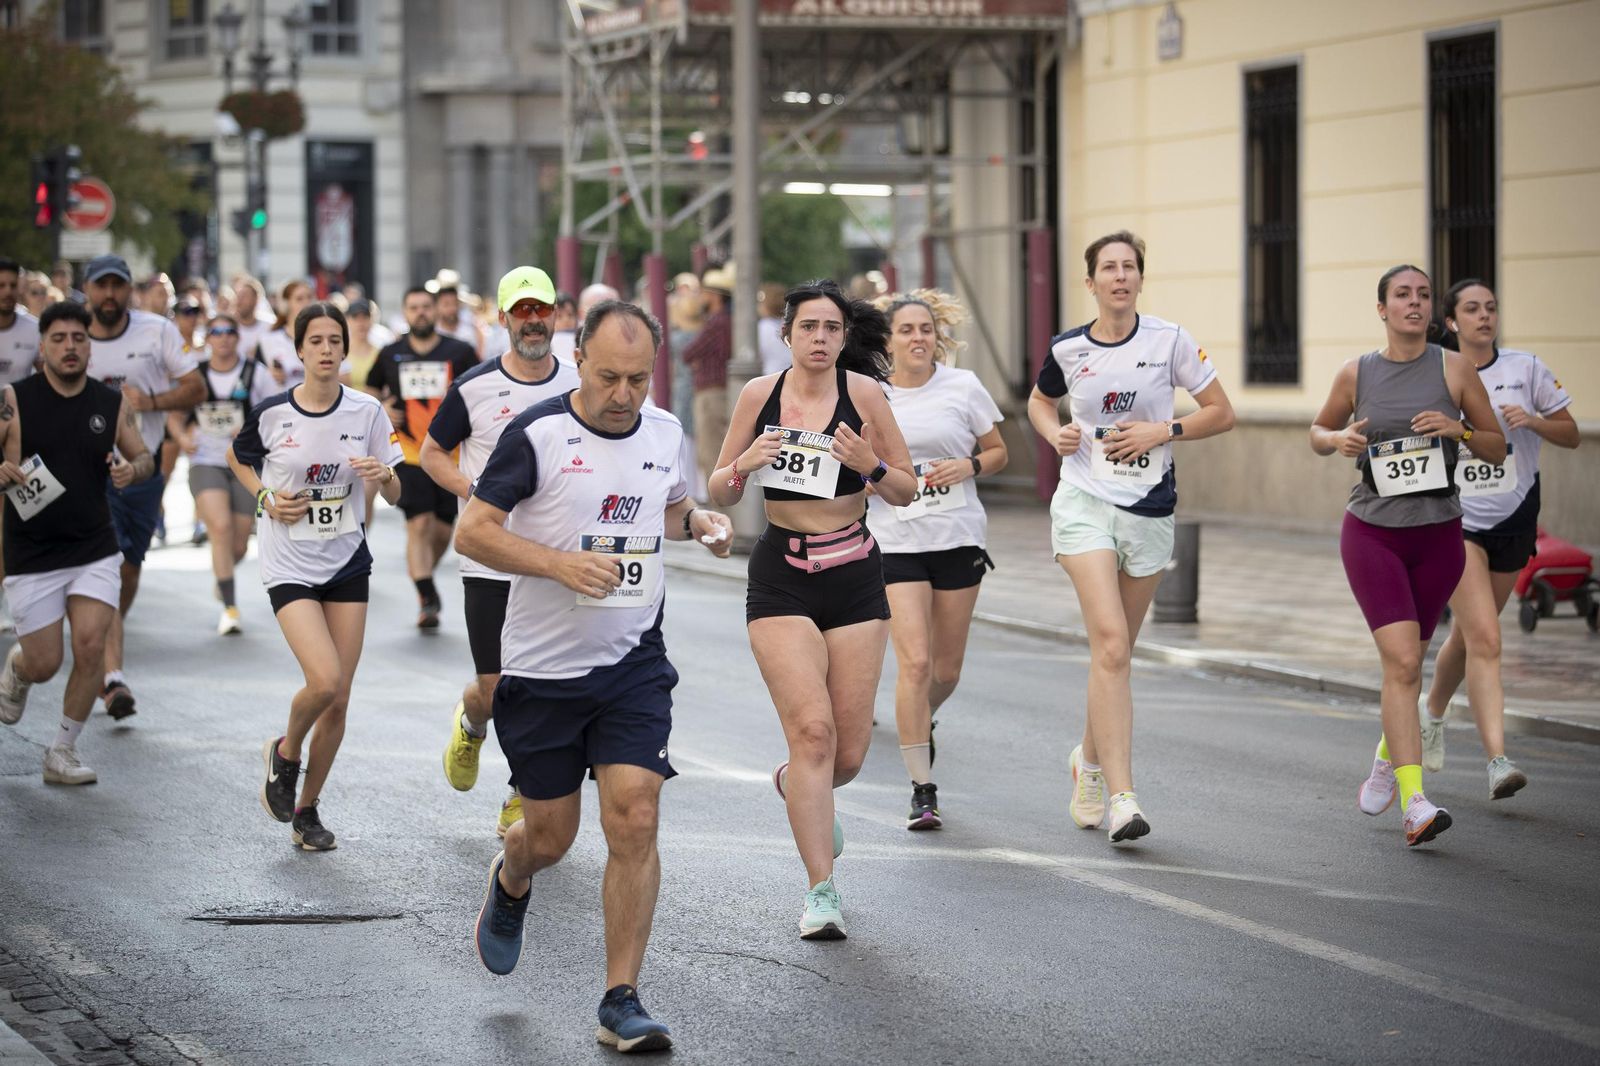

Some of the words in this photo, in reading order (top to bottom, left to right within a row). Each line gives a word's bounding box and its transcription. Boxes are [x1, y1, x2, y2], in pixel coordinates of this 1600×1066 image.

[769, 450, 821, 477] 581
[1386, 456, 1430, 480] 397
[1464, 465, 1506, 482] 695
[783, 475, 805, 485] JULIETTE
[16, 478, 47, 504] 932
[307, 505, 343, 525] 181
[592, 536, 615, 546] 200
